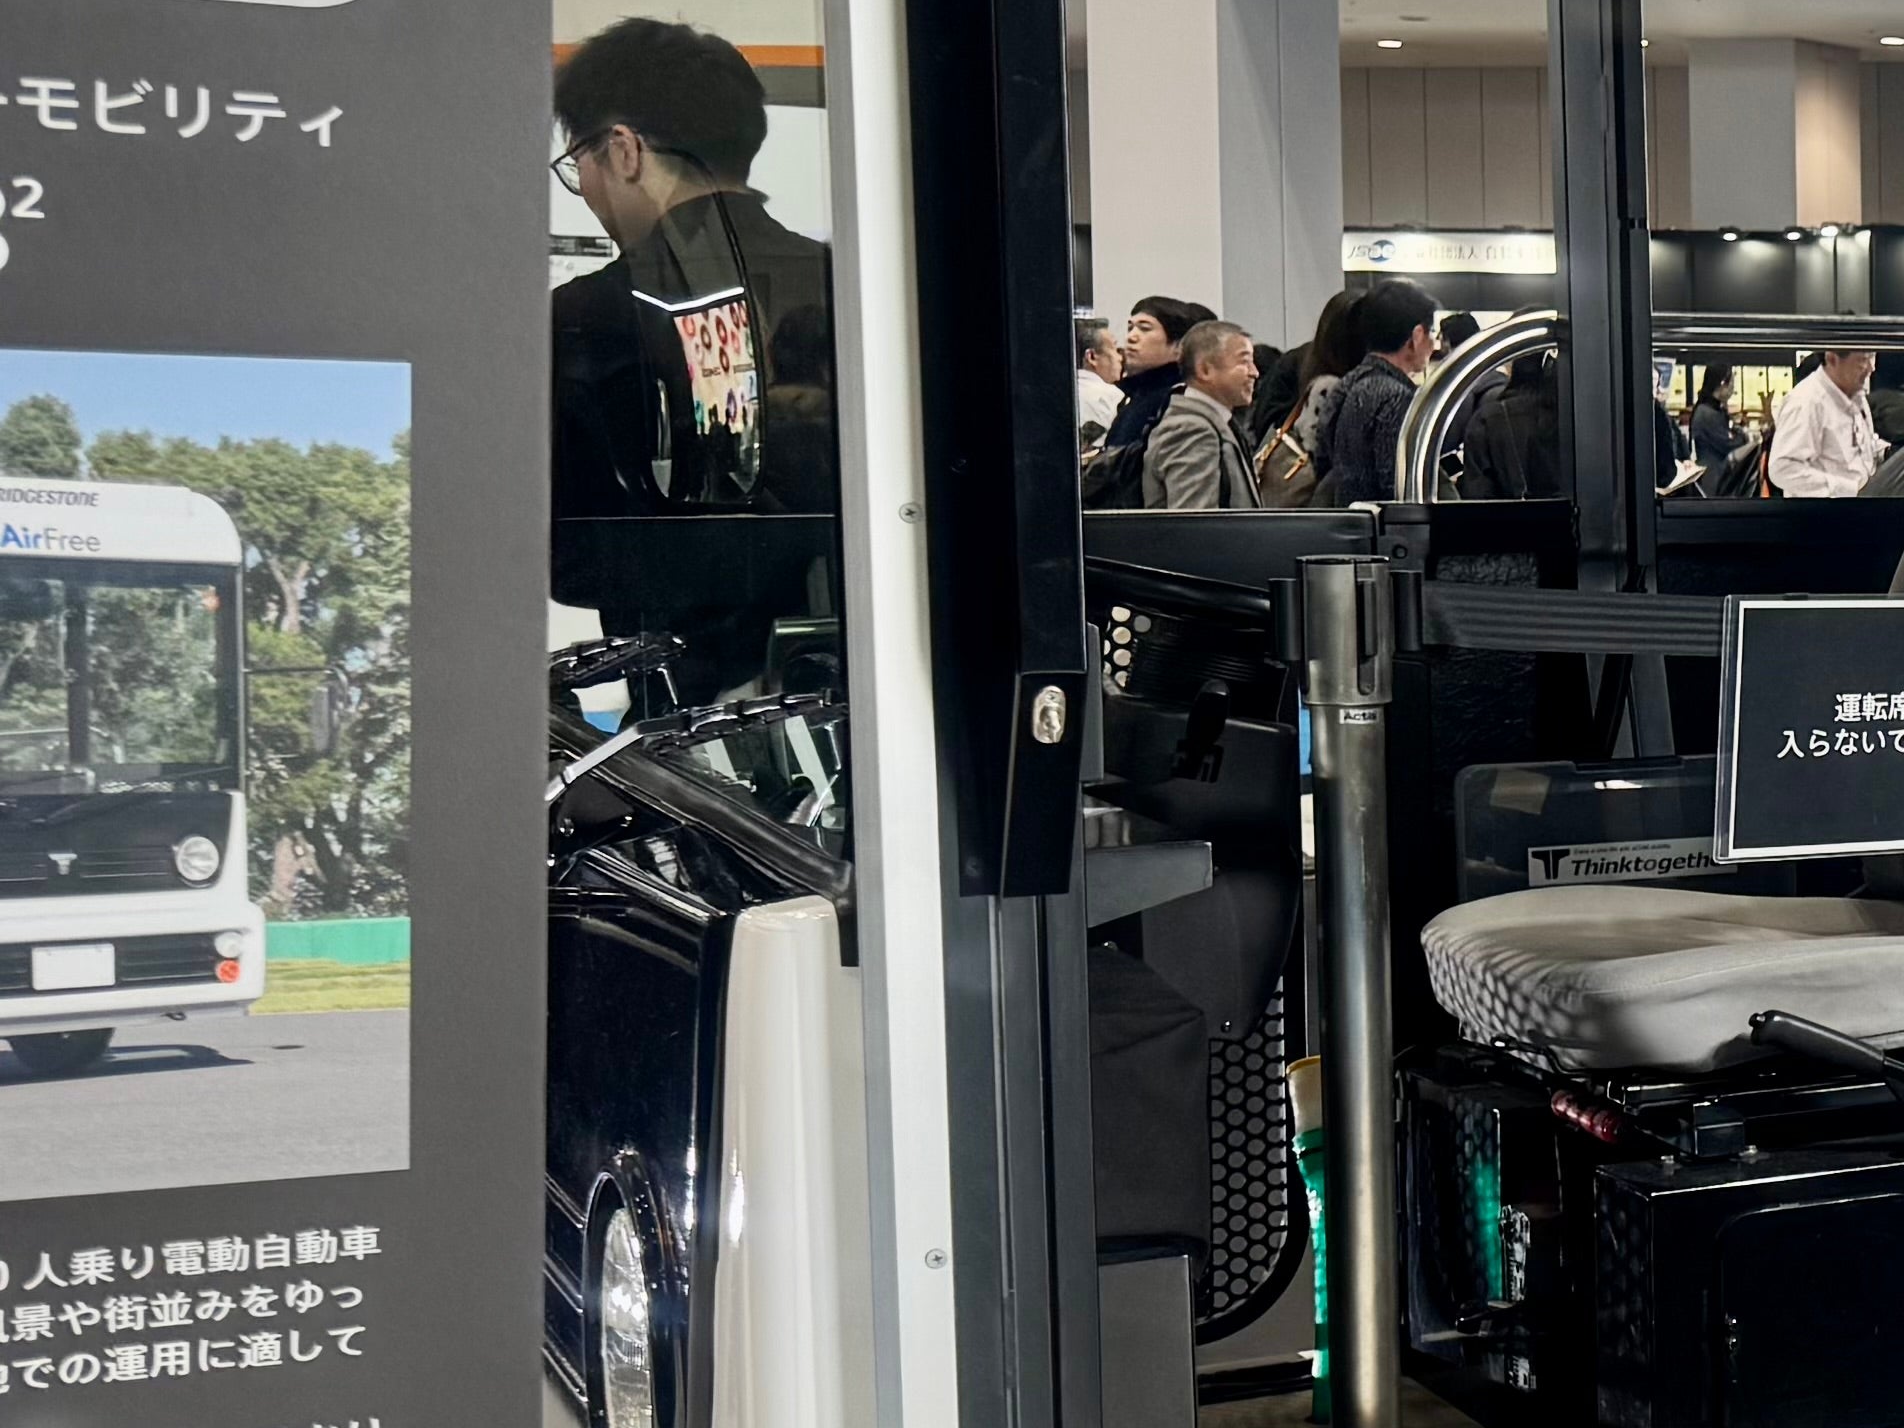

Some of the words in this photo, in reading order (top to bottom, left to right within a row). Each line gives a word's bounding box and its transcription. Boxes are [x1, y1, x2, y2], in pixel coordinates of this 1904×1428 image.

[0, 77, 343, 147] モビリティ
[0, 177, 45, 219] 2
[0, 523, 101, 552] AirFree
[0, 1279, 364, 1344] 景や街並みをゆっ
[0, 1325, 367, 1394] での運用に適して
